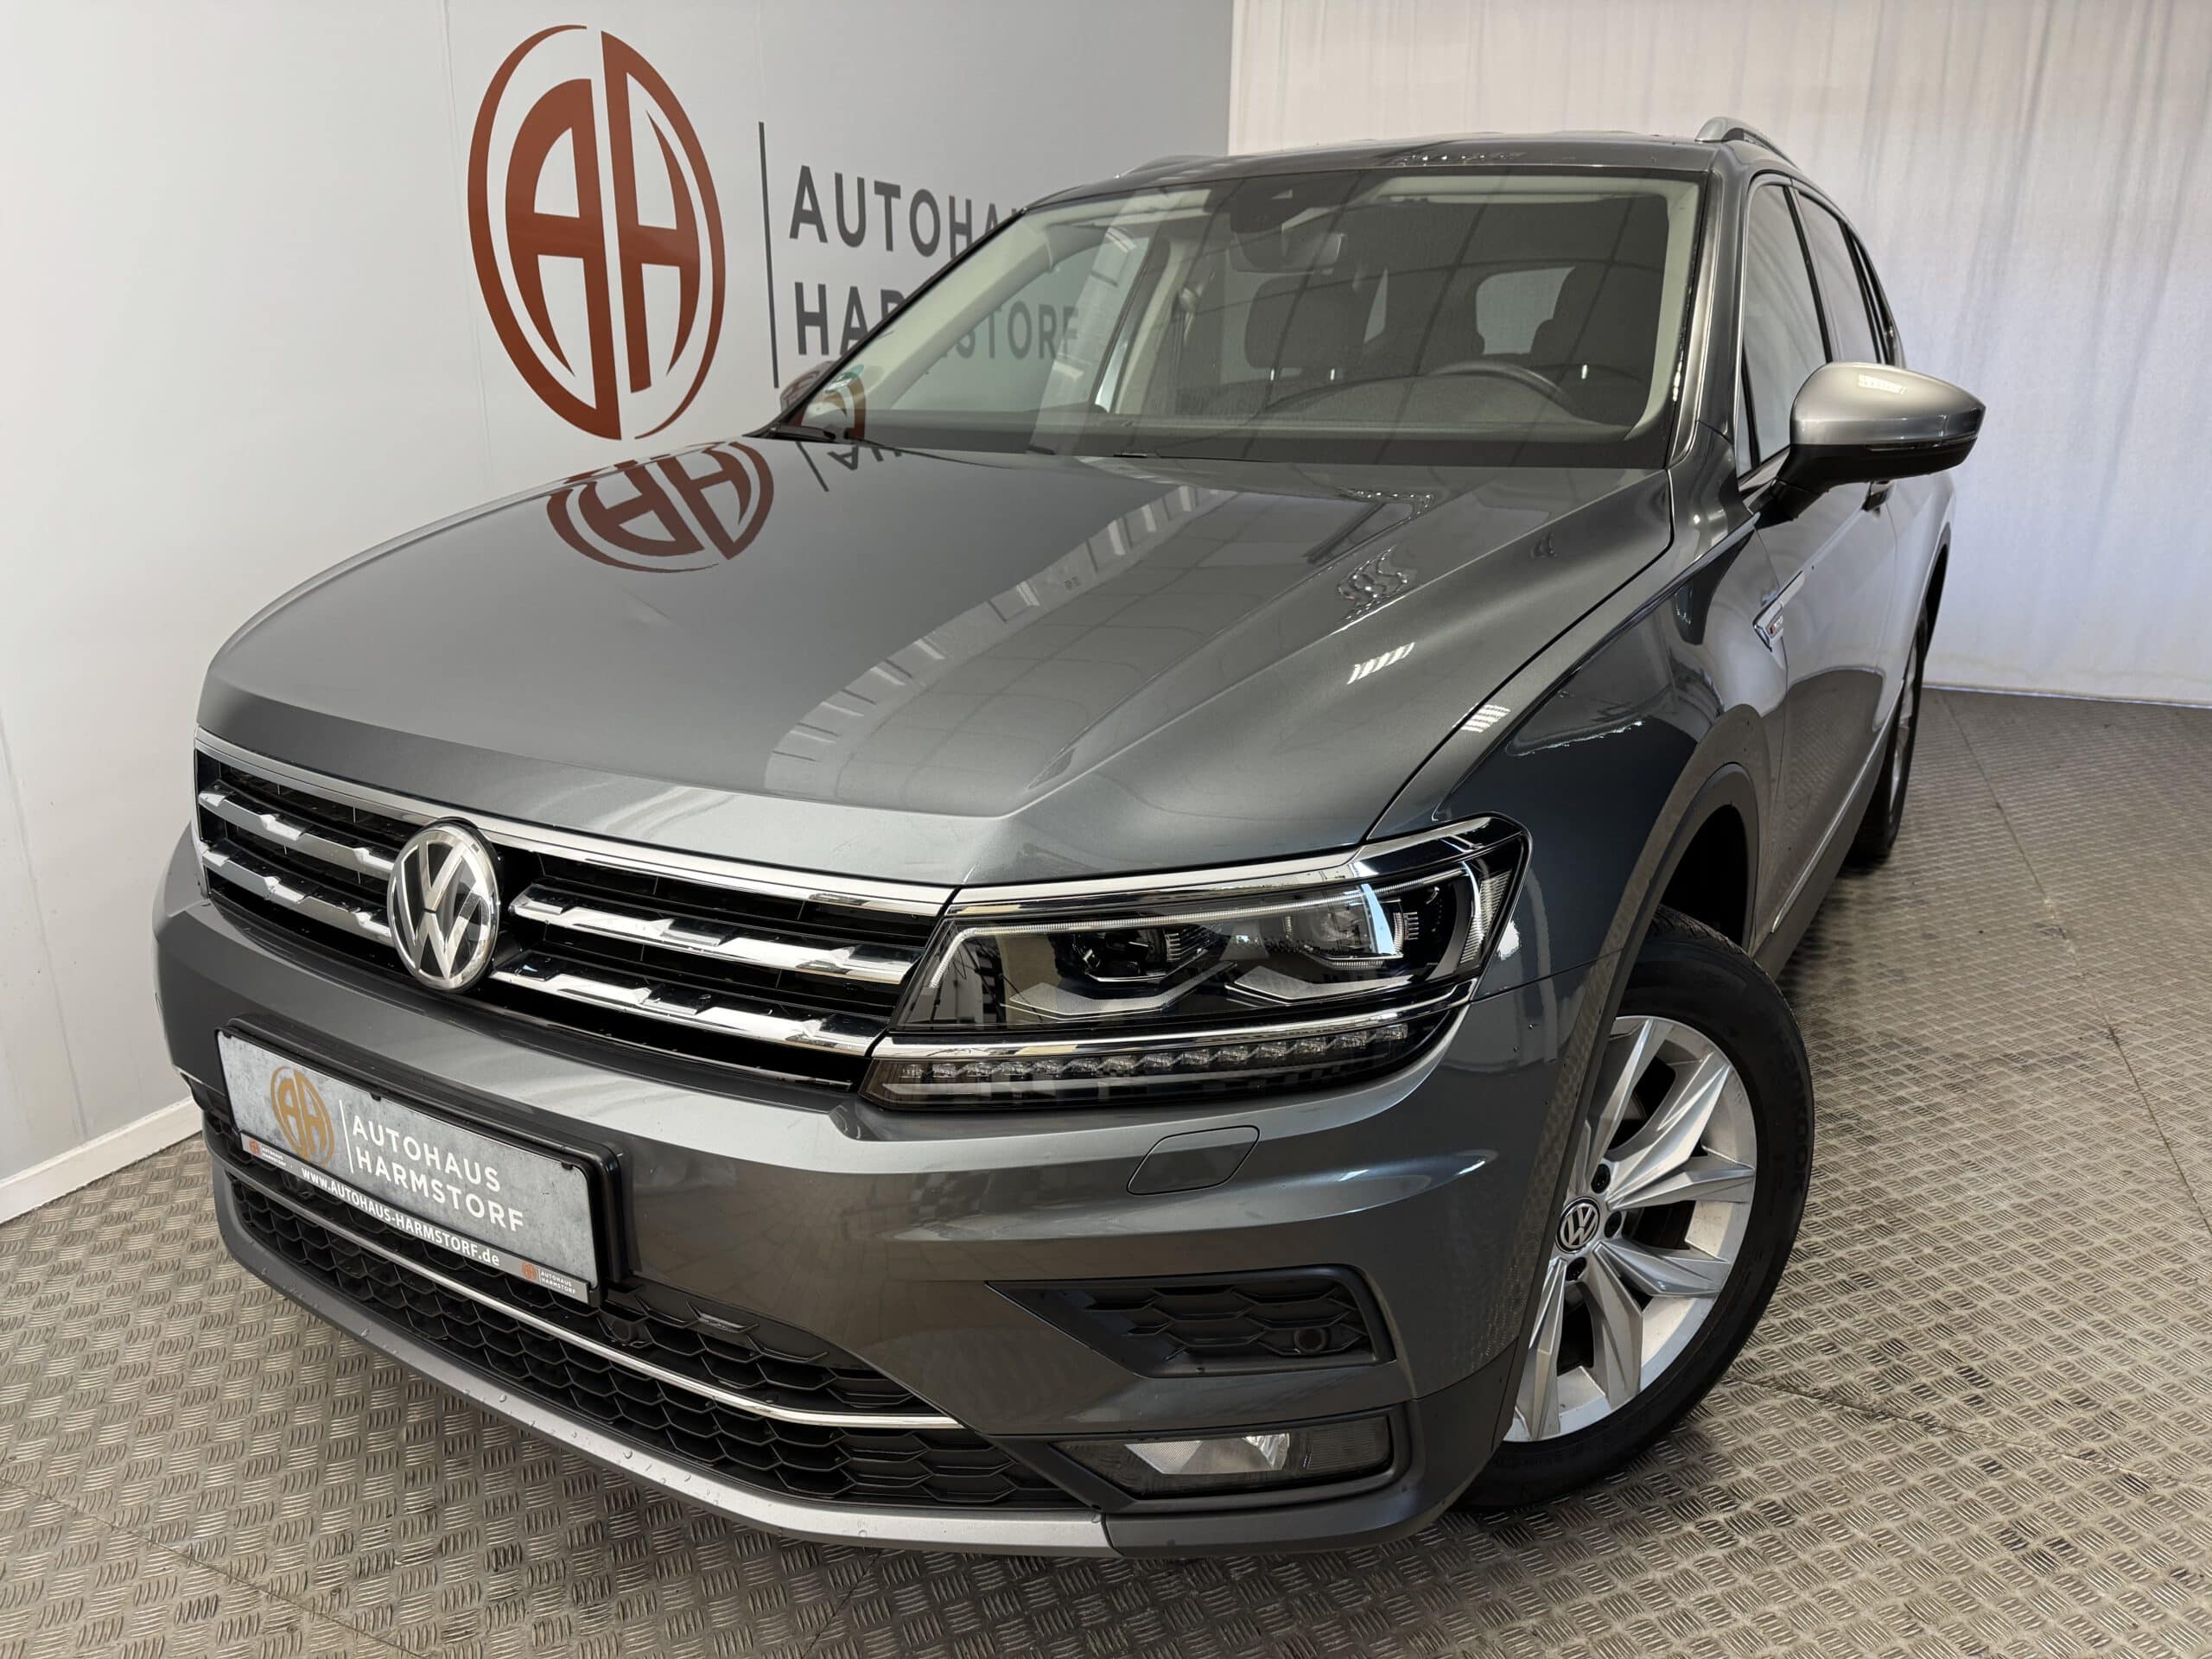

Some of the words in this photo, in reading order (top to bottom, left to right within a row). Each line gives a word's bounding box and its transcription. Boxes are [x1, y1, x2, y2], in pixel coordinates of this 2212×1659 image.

[789, 164, 1017, 259] AUTOH
[794, 281, 1078, 360] HATORF
[353, 1115, 501, 1192] AUTOHAUS
[356, 1147, 524, 1231] HARMSTORF
[301, 1167, 500, 1267] www.AUTOHAUS-HARMSTORF.de
[540, 1271, 573, 1287] AUTOHAUS
[541, 1277, 576, 1294] HARMSTORF
